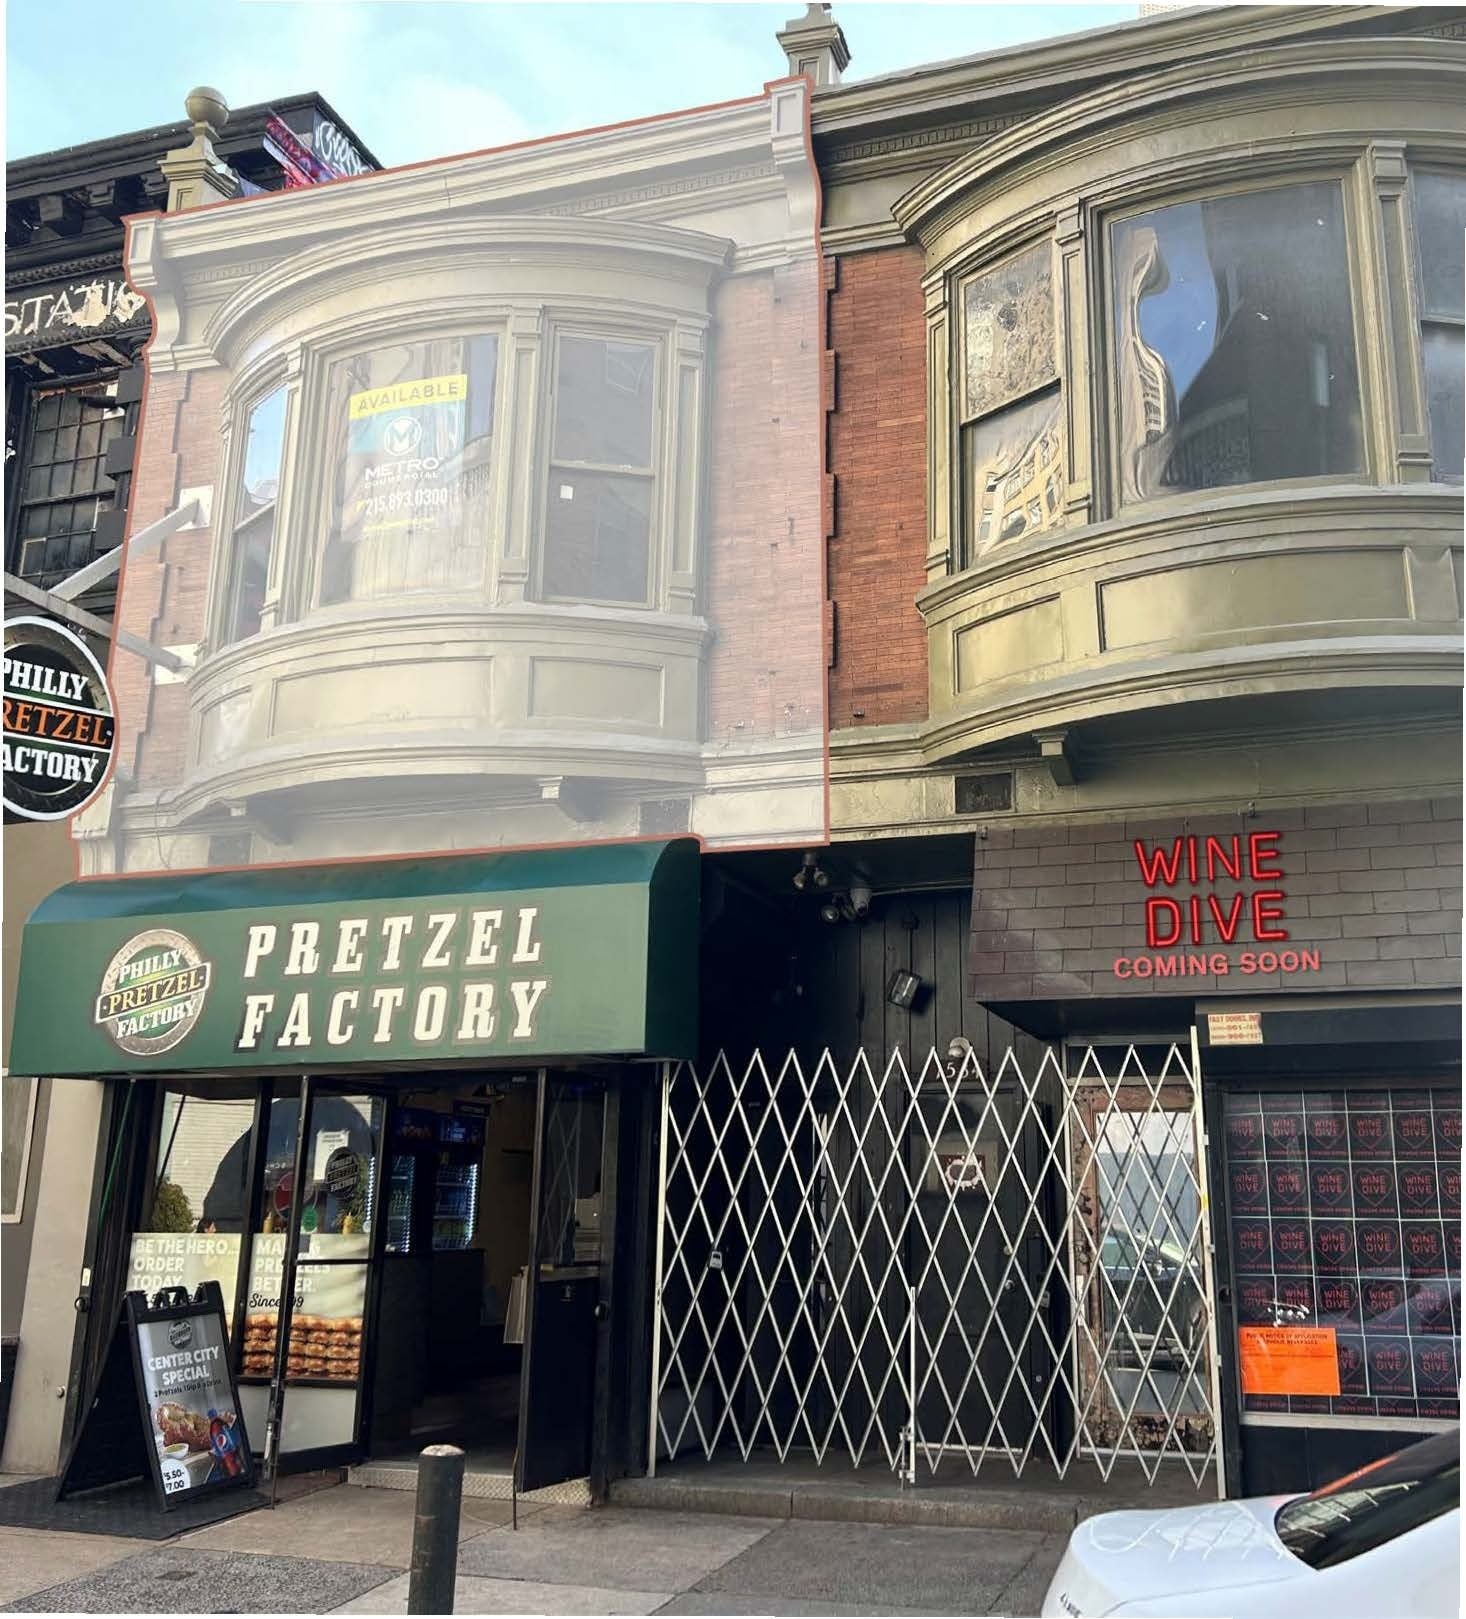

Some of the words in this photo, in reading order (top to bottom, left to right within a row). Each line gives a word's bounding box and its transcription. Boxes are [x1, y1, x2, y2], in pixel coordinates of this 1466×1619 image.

[357, 382, 459, 413] AVAILABLE
[364, 457, 440, 481] METRO
[3, 699, 107, 746] RETZEL
[3, 744, 99, 783] ACTORY
[1134, 832, 1282, 887] WINE
[1145, 889, 1288, 949] DIVE
[243, 907, 542, 979] PRETZEL
[118, 948, 182, 984] PHILLY
[1113, 953, 1230, 979] COMING
[1239, 949, 1321, 975] SOON
[108, 969, 201, 1015] PRETZEL
[116, 998, 198, 1039] FACTORY
[237, 980, 548, 1050] FACTORY
[1360, 1175, 1385, 1184] WINE
[1405, 1175, 1431, 1184] WINE
[1362, 1184, 1386, 1194] DIVE
[1407, 1185, 1432, 1194] DIVE
[1240, 1231, 1263, 1240] WINE
[1280, 1231, 1304, 1240] WINE
[1320, 1233, 1346, 1241] WINE
[1364, 1232, 1390, 1241] WINE
[1410, 1234, 1435, 1243] WINE
[135, 1239, 157, 1255] BE
[158, 1239, 185, 1255] THE
[1240, 1241, 1264, 1249] DIVE
[1281, 1241, 1305, 1249] DIVE
[1321, 1243, 1347, 1252] DIVE
[1366, 1243, 1392, 1252] DIVE
[1412, 1244, 1437, 1253] DIVE
[133, 1257, 185, 1272] ORDER
[132, 1275, 183, 1290] TODAY
[1369, 1289, 1394, 1298] WINE
[249, 1293, 282, 1308] Since
[1371, 1301, 1396, 1309] DIVE
[147, 1351, 196, 1372] CENTER
[193, 1346, 220, 1364] CITY
[1421, 1351, 1448, 1360] WINE
[1423, 1361, 1449, 1371] DIVE
[162, 1365, 210, 1386] SPECIAL
